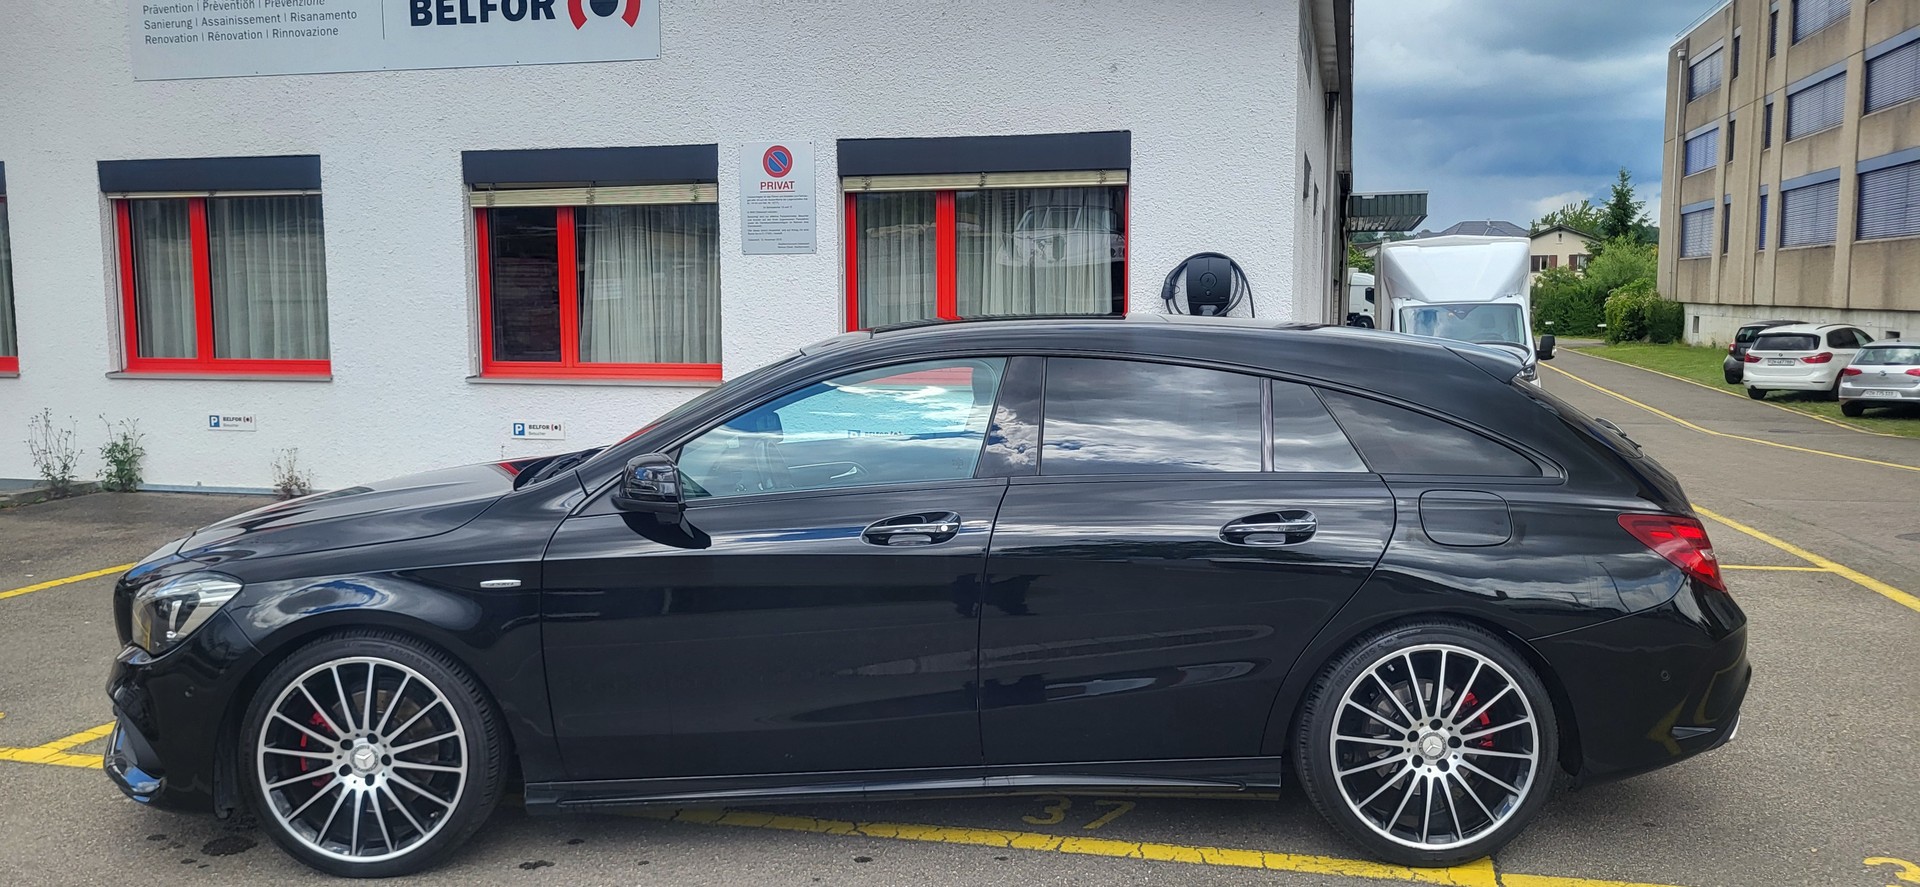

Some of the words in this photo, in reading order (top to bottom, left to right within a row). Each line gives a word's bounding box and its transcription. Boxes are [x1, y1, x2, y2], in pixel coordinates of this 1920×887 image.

[143, 4, 194, 15] Prävention
[410, 0, 556, 27] BELFOR
[144, 18, 193, 30] Sanierung
[201, 14, 281, 27] Assainissement
[290, 10, 357, 22] Risanamento
[145, 32, 199, 45] Renovation
[207, 30, 263, 42] Rénovation
[272, 26, 339, 39] Rinnovazione
[760, 181, 795, 190] PRIVAT
[1022, 794, 1136, 830] 37
